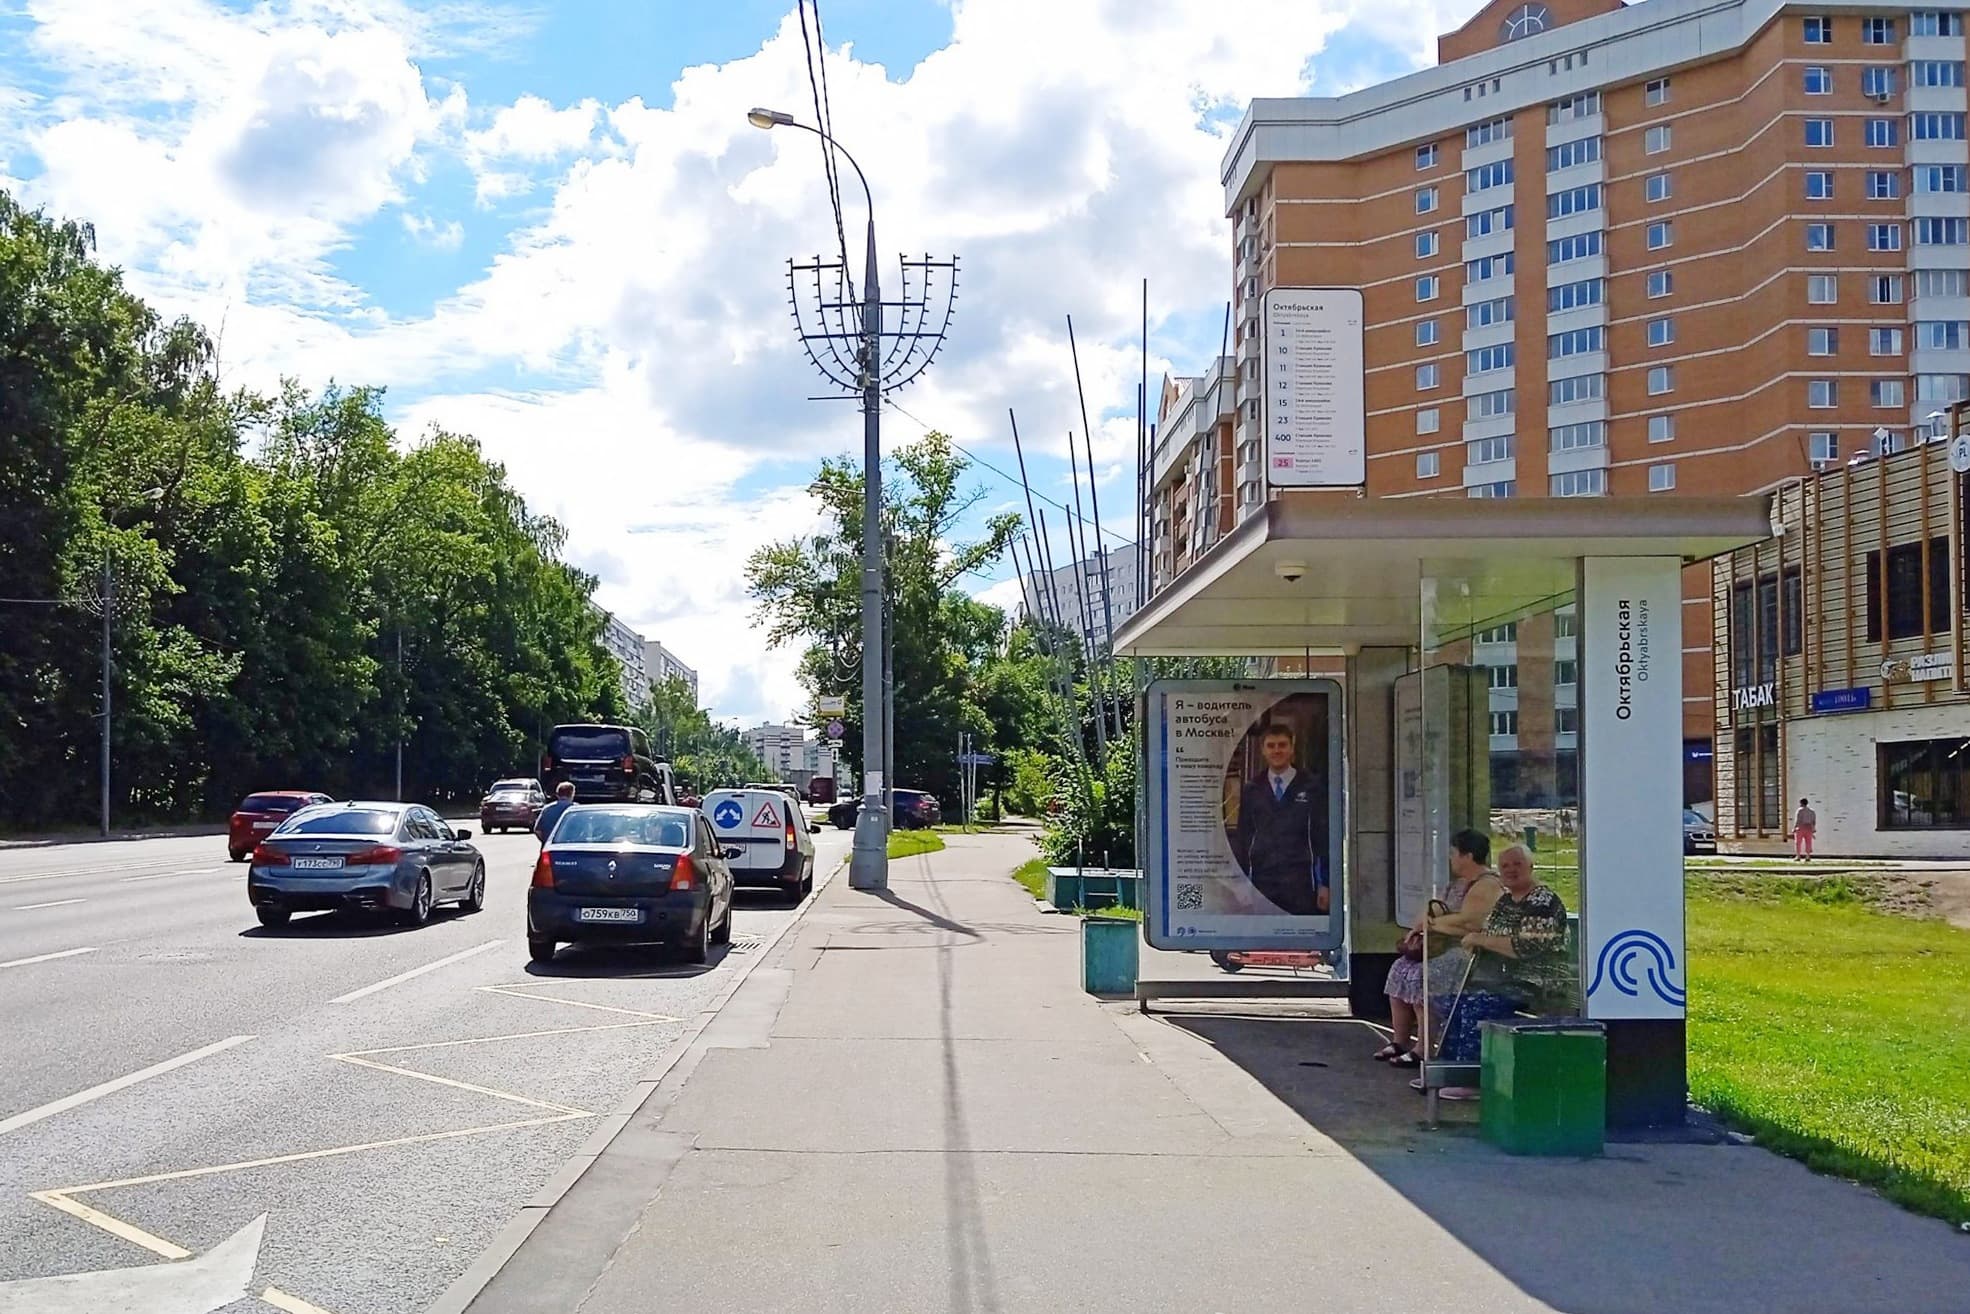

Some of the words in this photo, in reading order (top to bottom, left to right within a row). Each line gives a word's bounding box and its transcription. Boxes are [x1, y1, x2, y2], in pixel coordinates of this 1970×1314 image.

[1273, 303, 1323, 311] Октябрьская
[1279, 364, 1286, 372] 11
[1279, 381, 1287, 389] 12
[1279, 399, 1287, 407] 15
[1278, 416, 1288, 424] 23
[1278, 459, 1289, 467] 25
[1638, 600, 1650, 681] Oktyabrskaya
[1616, 600, 1633, 720] Октябрьская
[1732, 683, 1774, 711] ТАБАК
[1176, 700, 1184, 709] Я
[1198, 702, 1252, 711] водитель
[1176, 714, 1228, 726] автобуса
[1185, 728, 1234, 738] Москве!
